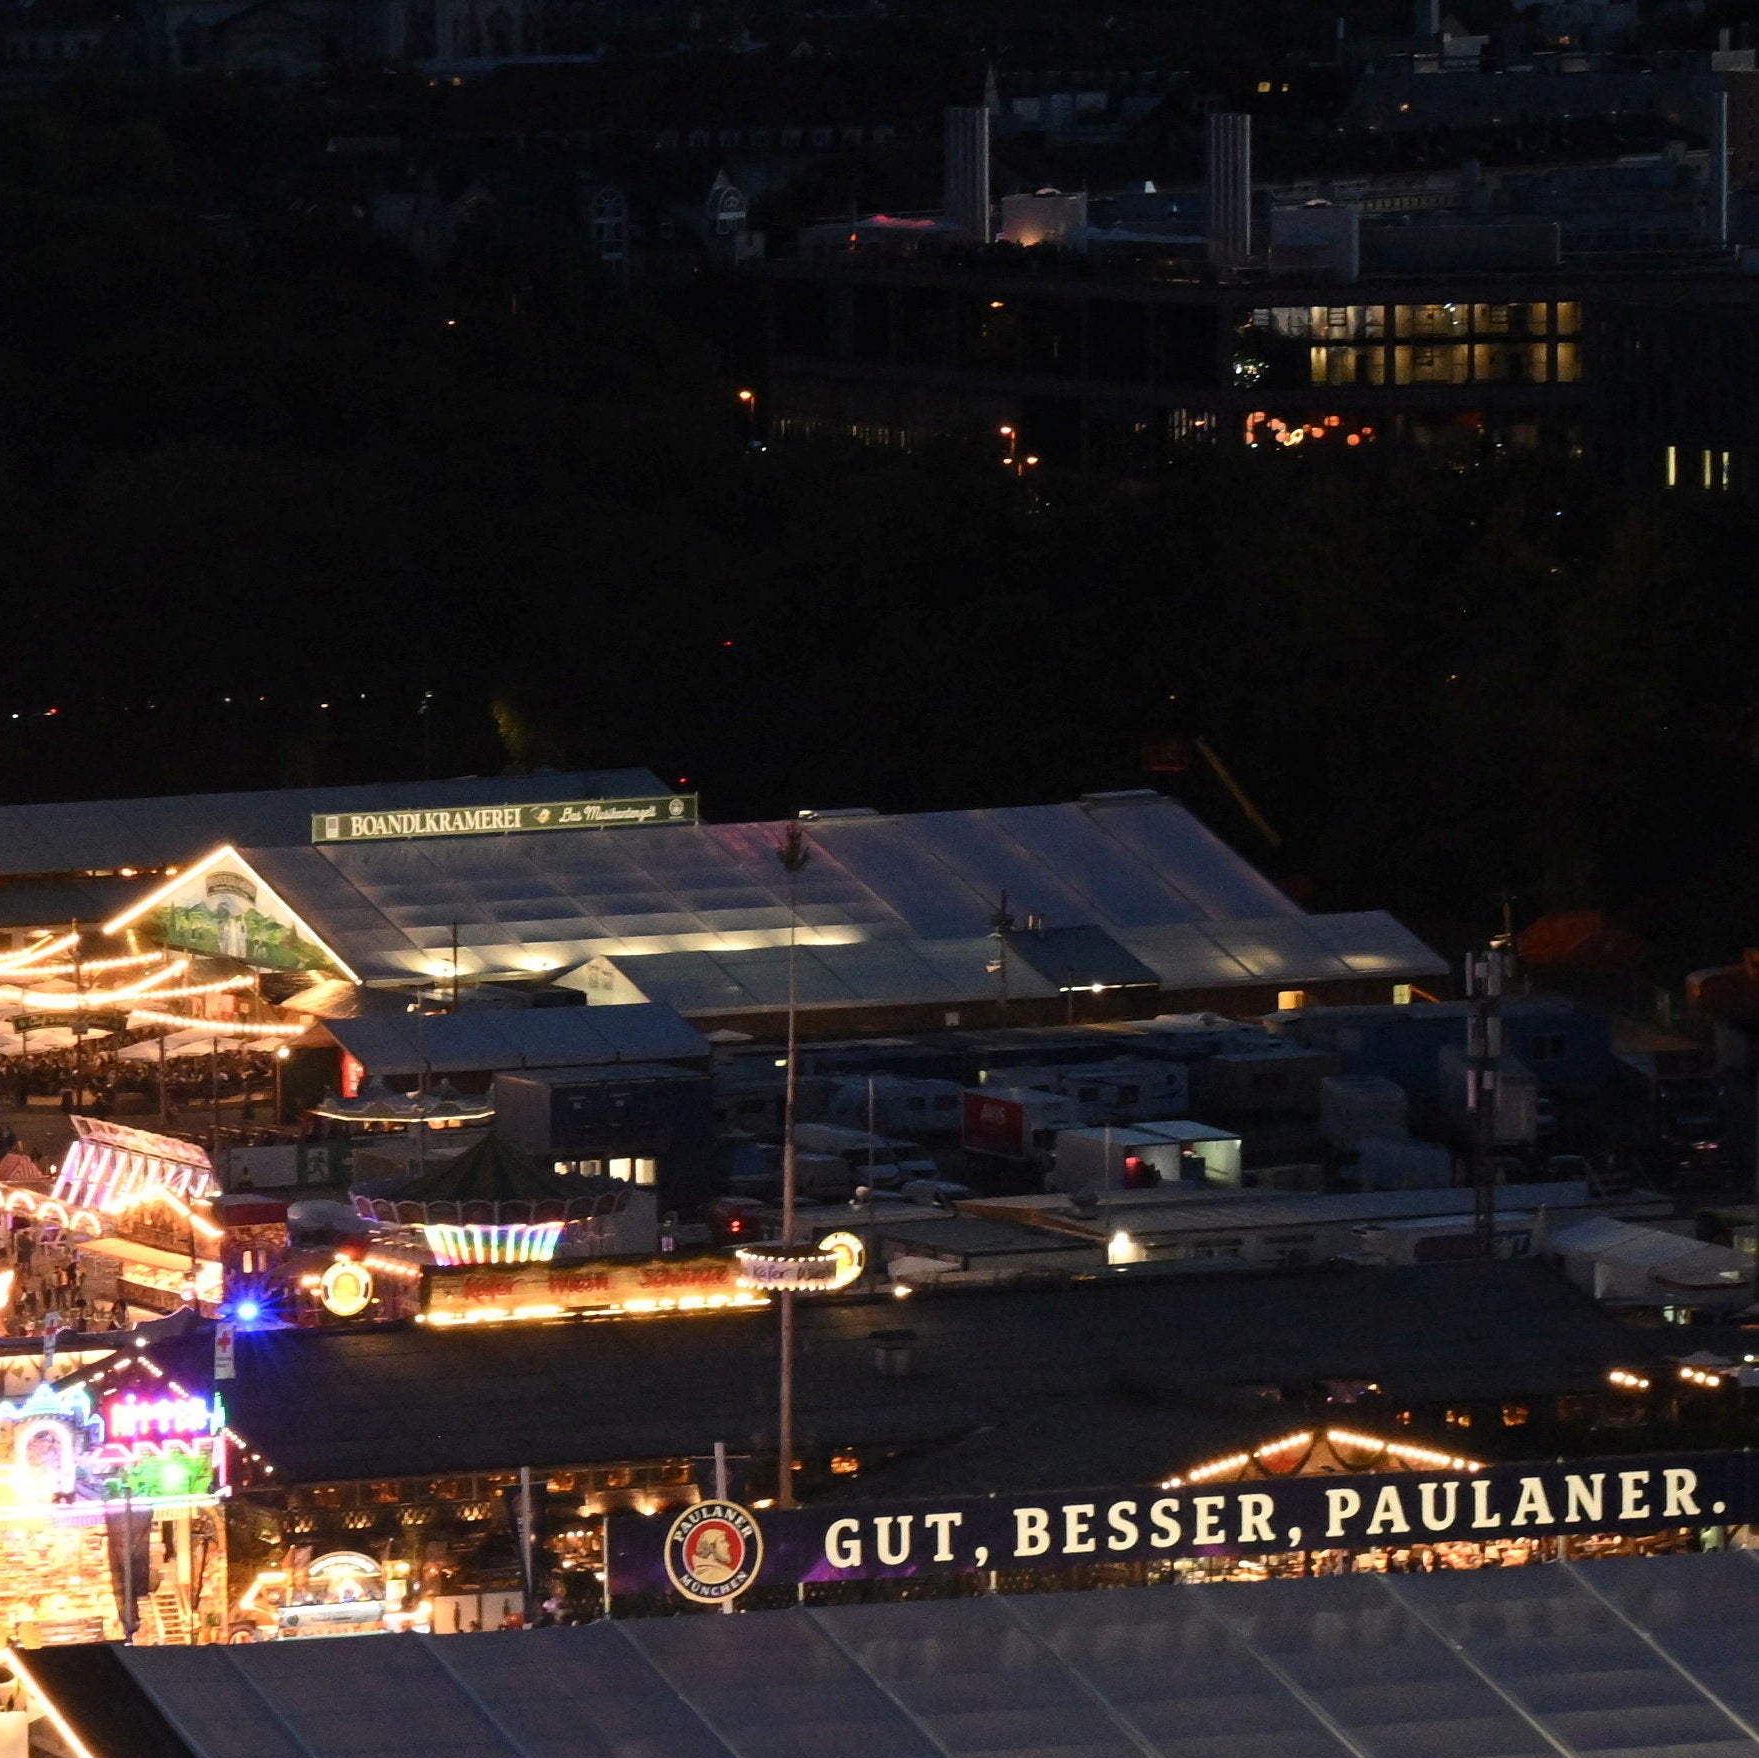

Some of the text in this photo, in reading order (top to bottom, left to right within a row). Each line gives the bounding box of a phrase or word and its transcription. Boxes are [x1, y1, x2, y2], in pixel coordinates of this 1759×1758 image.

[350, 807, 523, 838] BOANDLKRAMEREI
[673, 1505, 753, 1543] PAULANER
[823, 1466, 1727, 1569] GUT, BESSER, PAULANER.
[679, 1570, 748, 1596] MÜNCHEN
